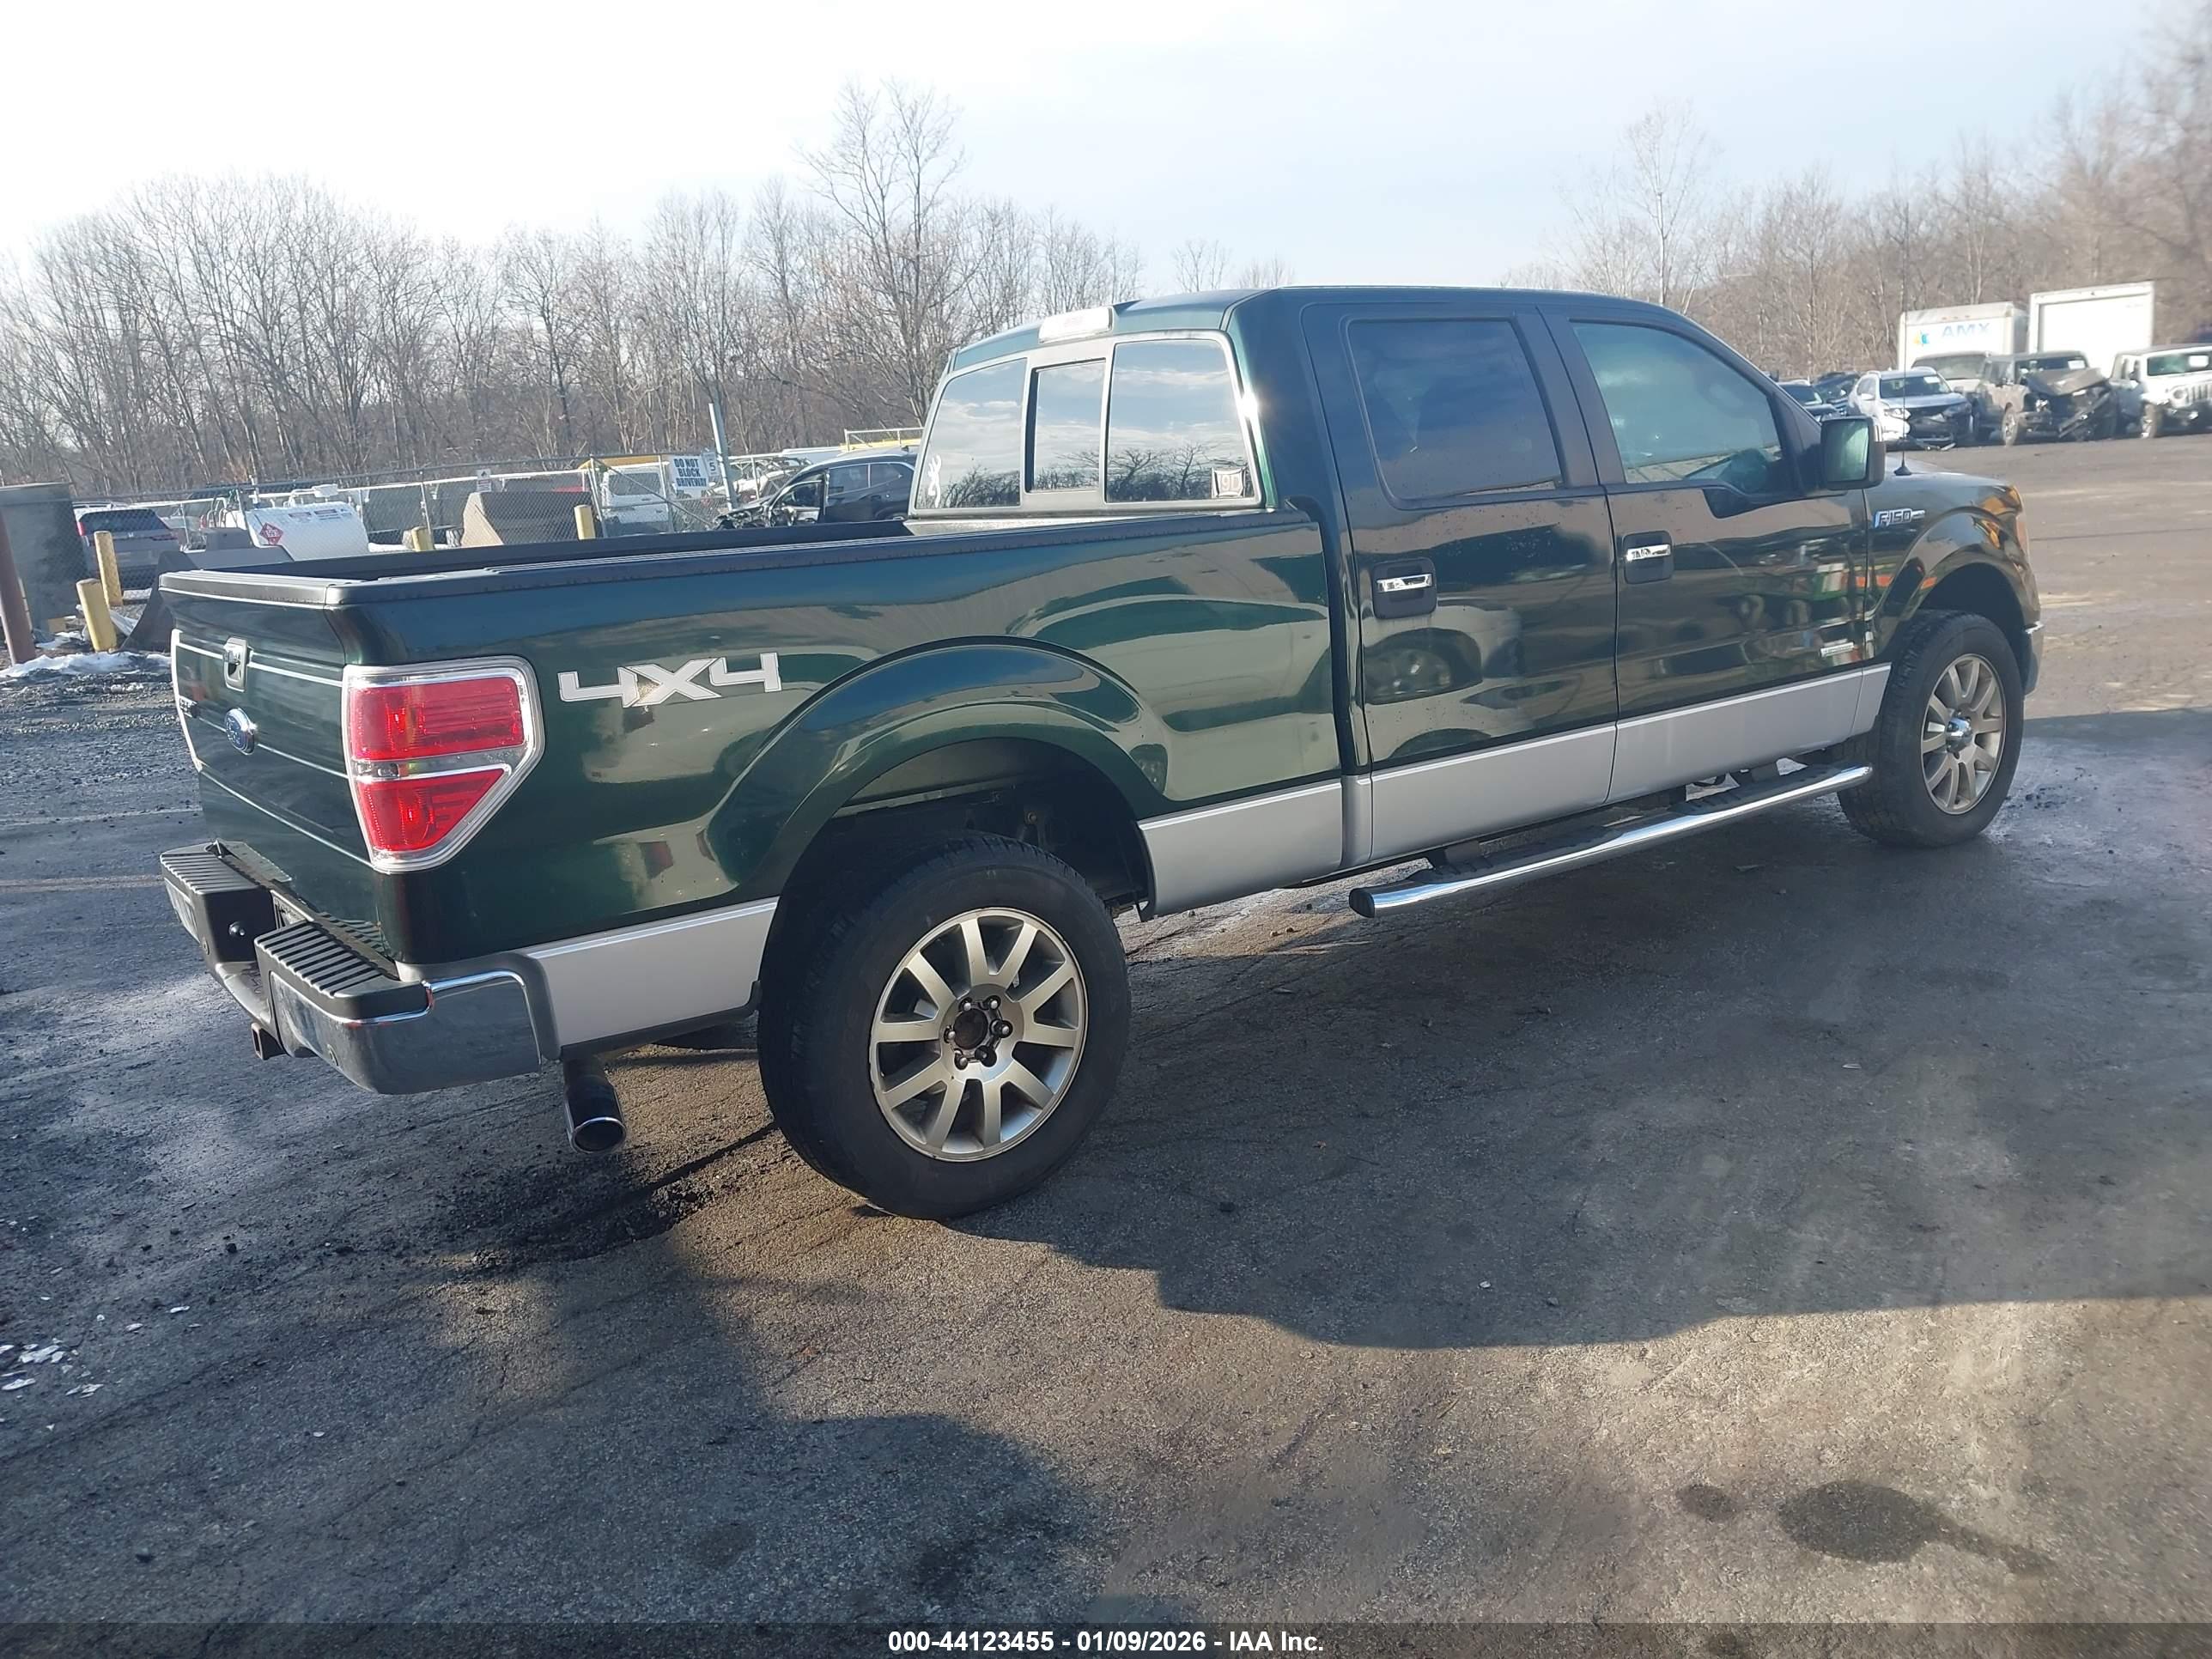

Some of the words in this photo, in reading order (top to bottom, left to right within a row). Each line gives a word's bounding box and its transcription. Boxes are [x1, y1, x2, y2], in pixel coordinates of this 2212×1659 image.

[673, 459, 684, 467] DO
[684, 459, 699, 467] NOT
[709, 462, 716, 471] 5
[678, 468, 701, 477] BLOCK
[557, 652, 782, 708] 4X4
